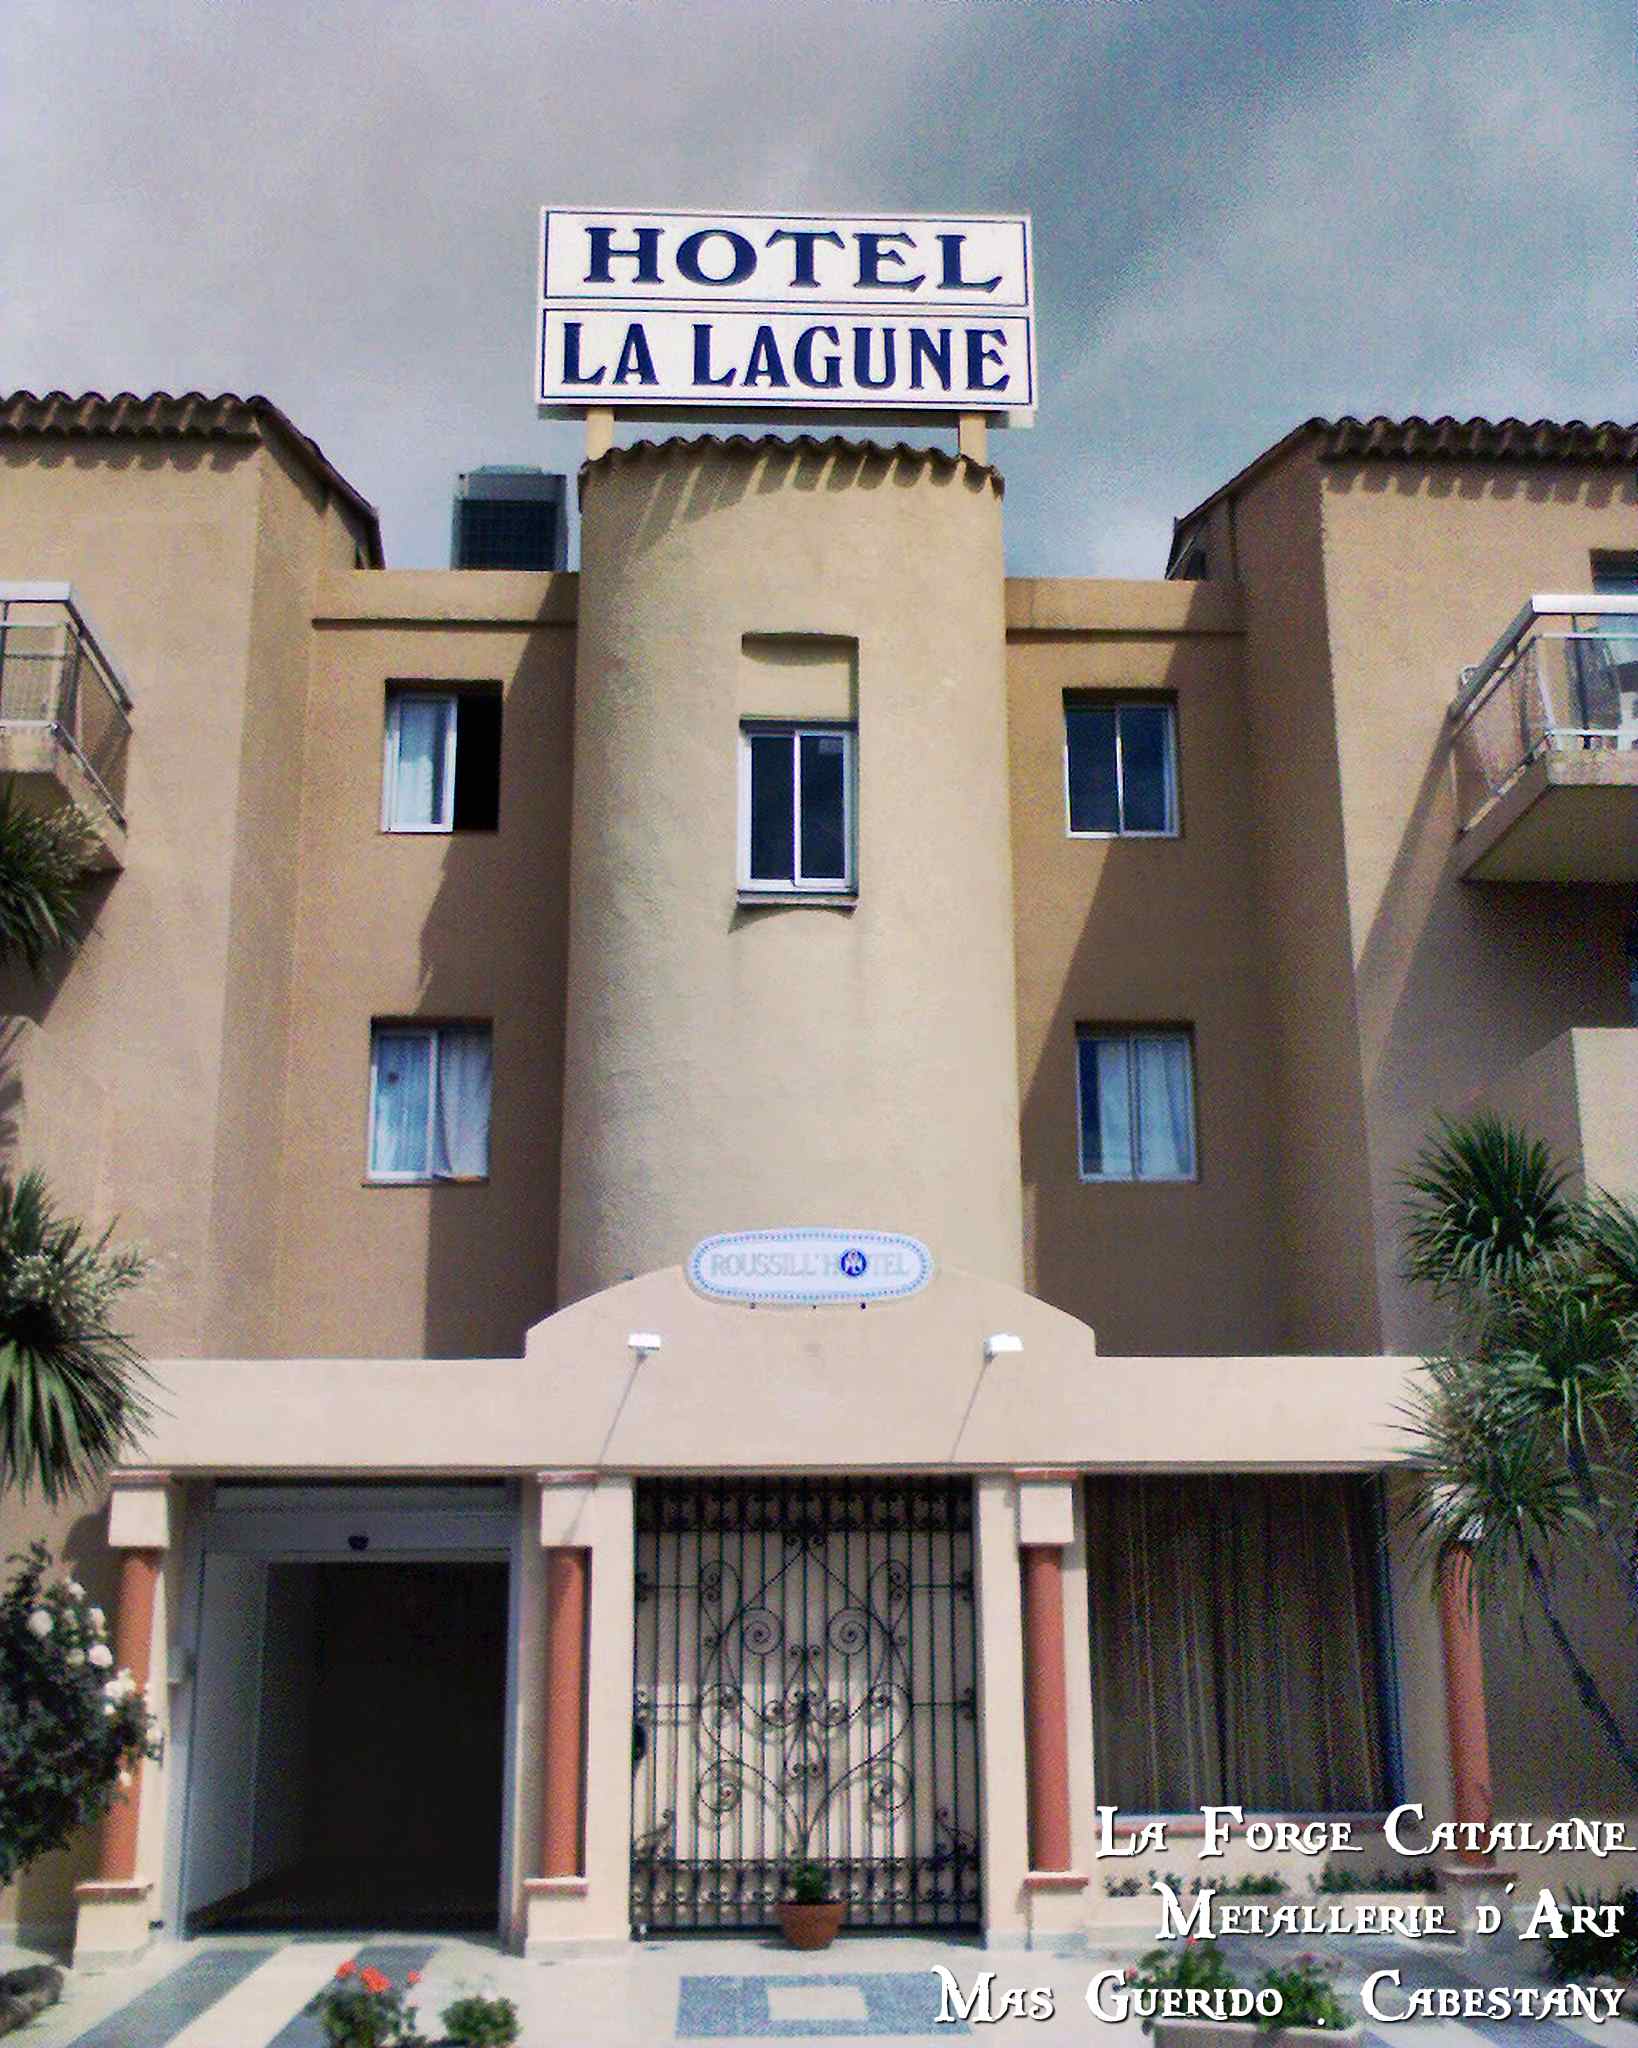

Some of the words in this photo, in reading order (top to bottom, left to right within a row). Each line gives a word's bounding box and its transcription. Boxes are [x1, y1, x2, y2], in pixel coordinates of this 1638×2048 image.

[582, 226, 1004, 293] HOTEL
[561, 321, 660, 386] LA
[692, 323, 1011, 392] LAGUNE
